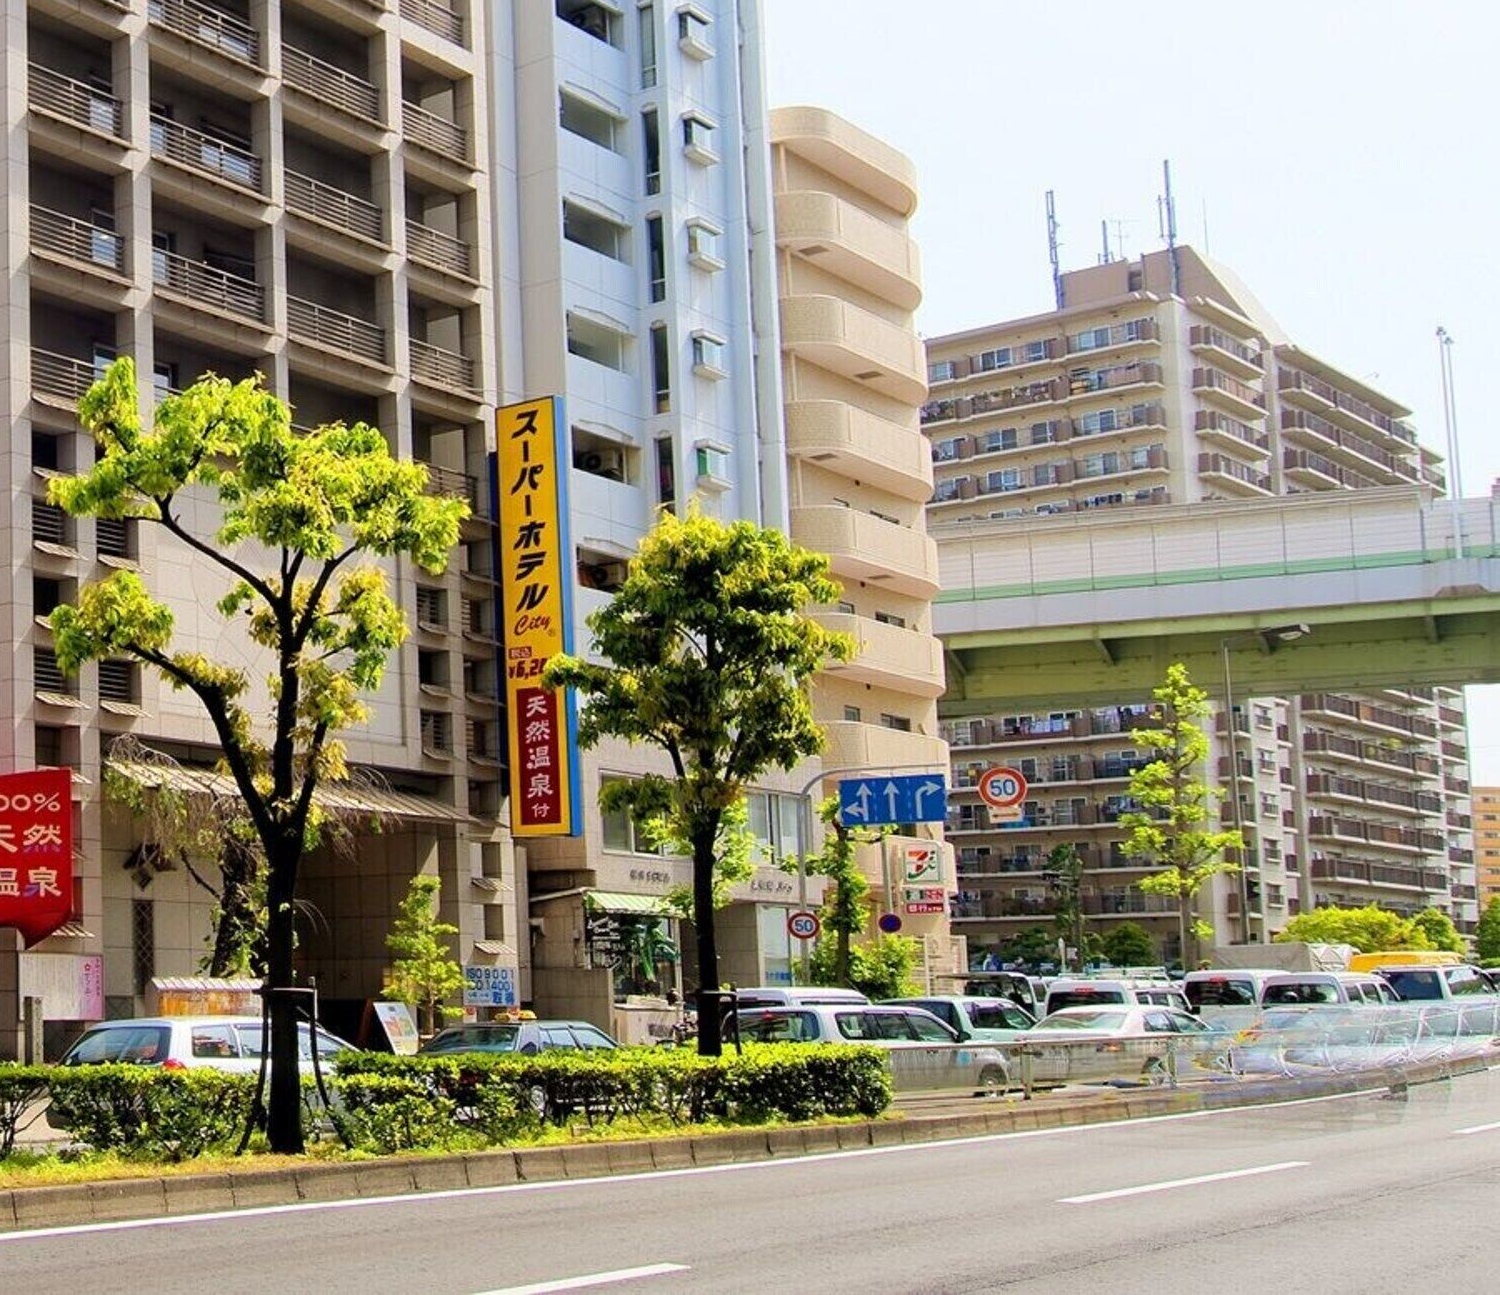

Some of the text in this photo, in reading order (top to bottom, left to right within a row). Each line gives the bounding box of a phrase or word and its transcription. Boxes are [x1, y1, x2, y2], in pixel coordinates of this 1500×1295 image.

[511, 409, 550, 613] スーパーホテル
[513, 614, 551, 636] City
[990, 779, 1016, 797] 50
[794, 919, 814, 933] 50
